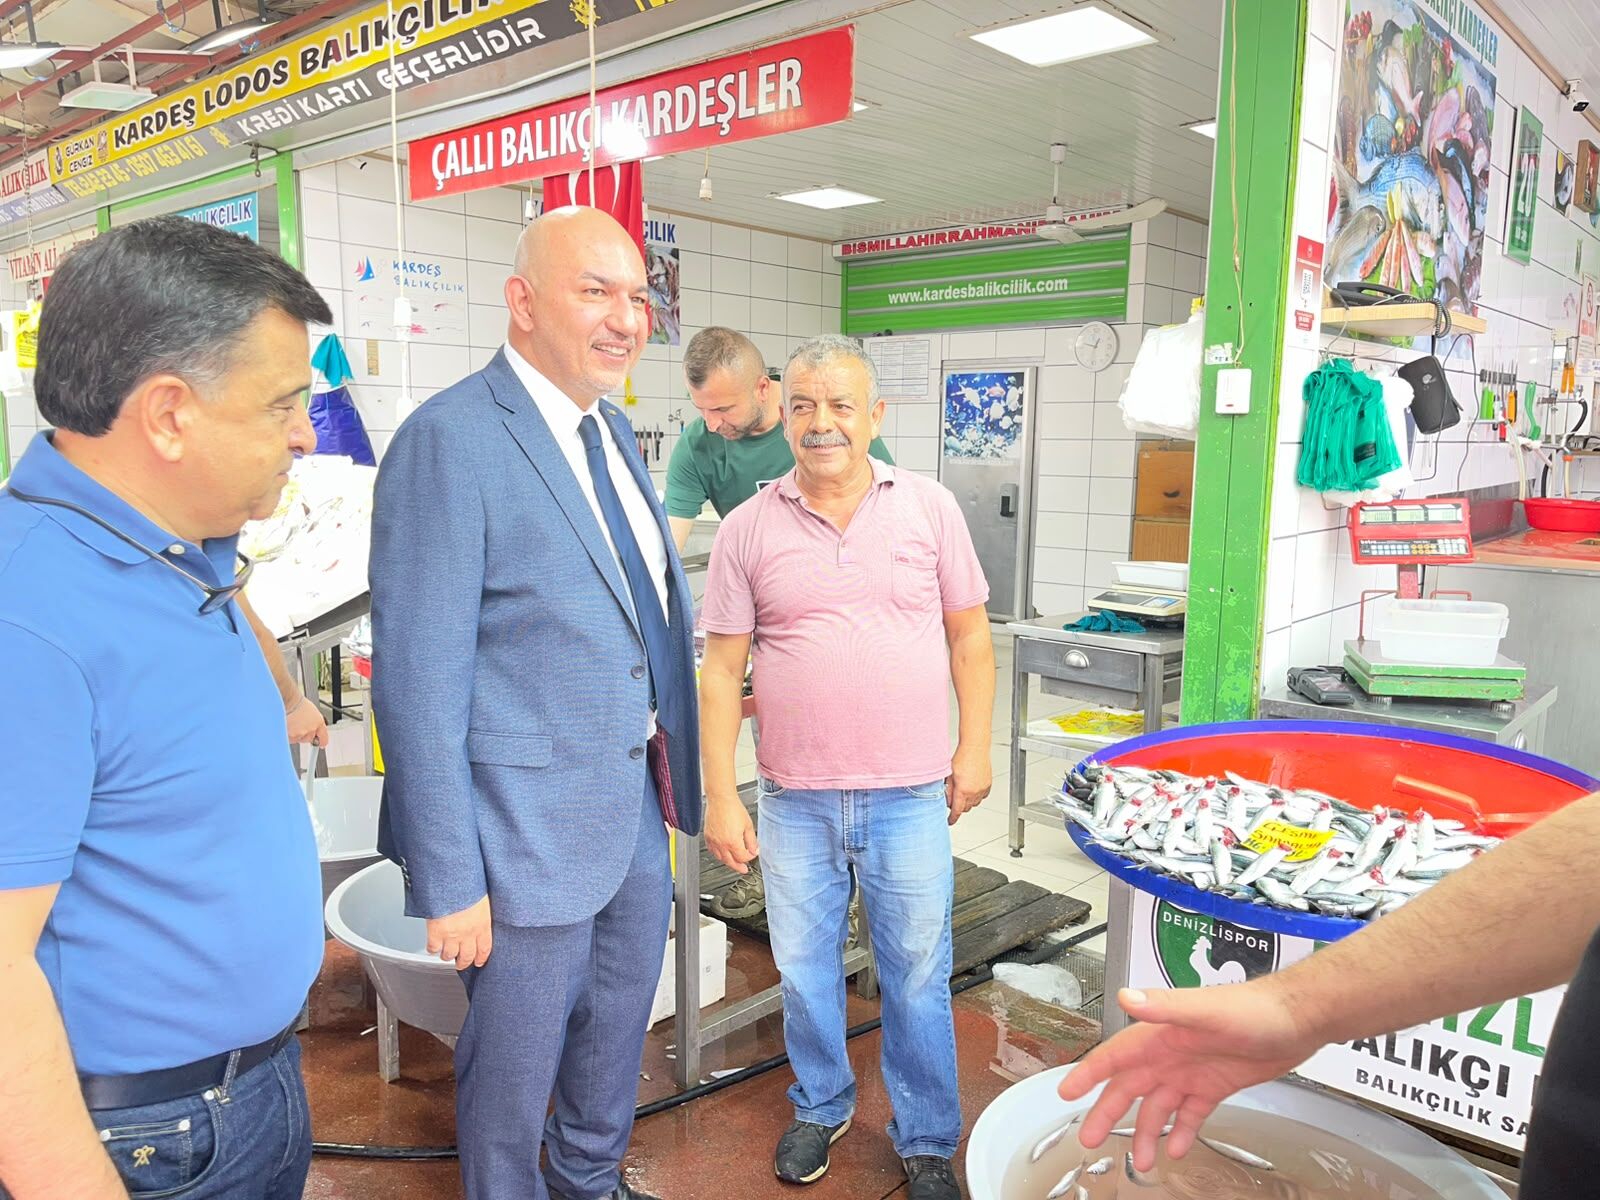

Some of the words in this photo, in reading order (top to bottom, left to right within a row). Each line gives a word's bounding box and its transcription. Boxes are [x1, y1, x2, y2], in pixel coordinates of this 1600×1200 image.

[114, 98, 196, 148] KARDEŞ
[204, 60, 289, 113] LODOS
[301, 0, 492, 76] BALIKÇIL
[237, 99, 301, 137] KREDİ
[297, 78, 372, 118] KARTI
[376, 17, 546, 90] GEÇERLİDİR
[431, 131, 494, 190] ÇALLI
[502, 104, 601, 166] BALIKÇI
[611, 58, 803, 147] KARDEŞLER
[393, 261, 442, 277] KARDEŞ
[394, 275, 465, 292] BALIKÇILIK
[888, 279, 1068, 304] www.kardesbalikcilik.com
[1163, 911, 1269, 953] DENİZLİSPOR
[1350, 1031, 1511, 1099] ALIKÇI
[1355, 1067, 1493, 1128] BALIKÇILIK
[1500, 1115, 1529, 1137] SA
